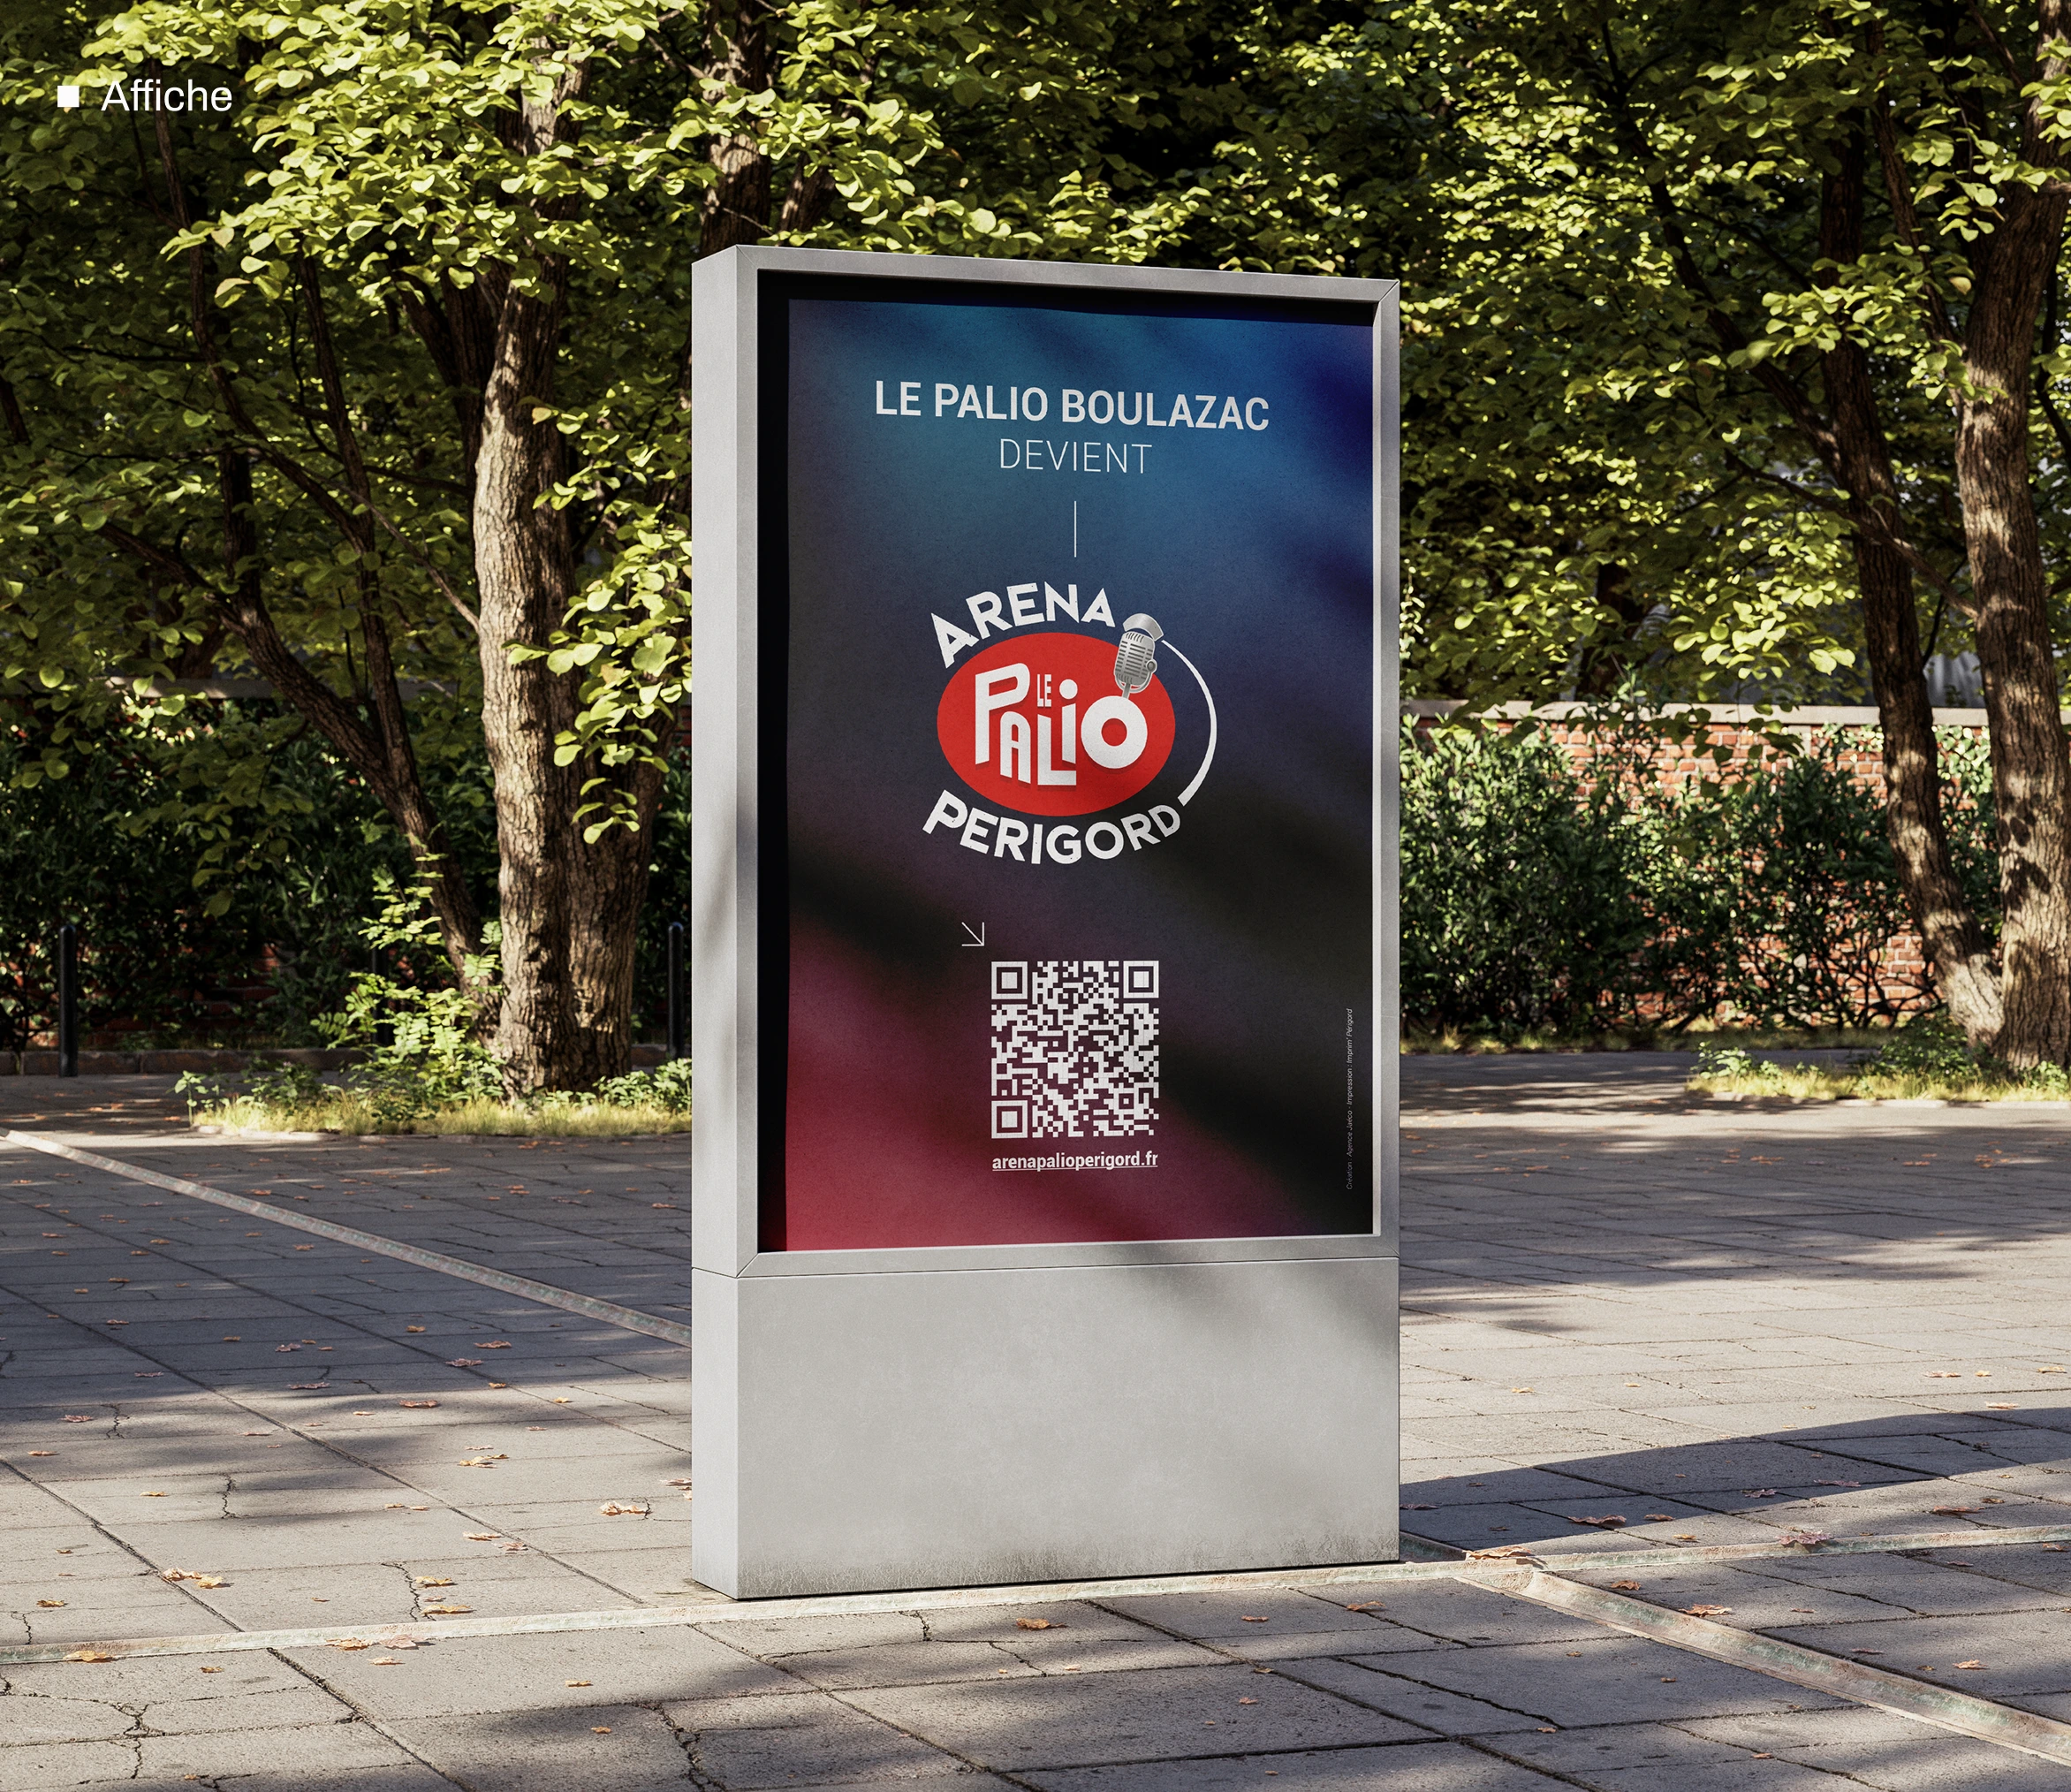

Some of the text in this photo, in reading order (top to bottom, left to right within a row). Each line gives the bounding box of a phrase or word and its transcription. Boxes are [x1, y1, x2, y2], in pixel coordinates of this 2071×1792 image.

[875, 380, 1270, 431] LE PALIO BOULAZAC
[999, 438, 1153, 475] DEVIENT
[929, 581, 1116, 669] ARENA
[1036, 673, 1052, 708] LE
[922, 790, 1182, 864] PERIGORD
[992, 1150, 1158, 1172] arenapalioperigord.fr
